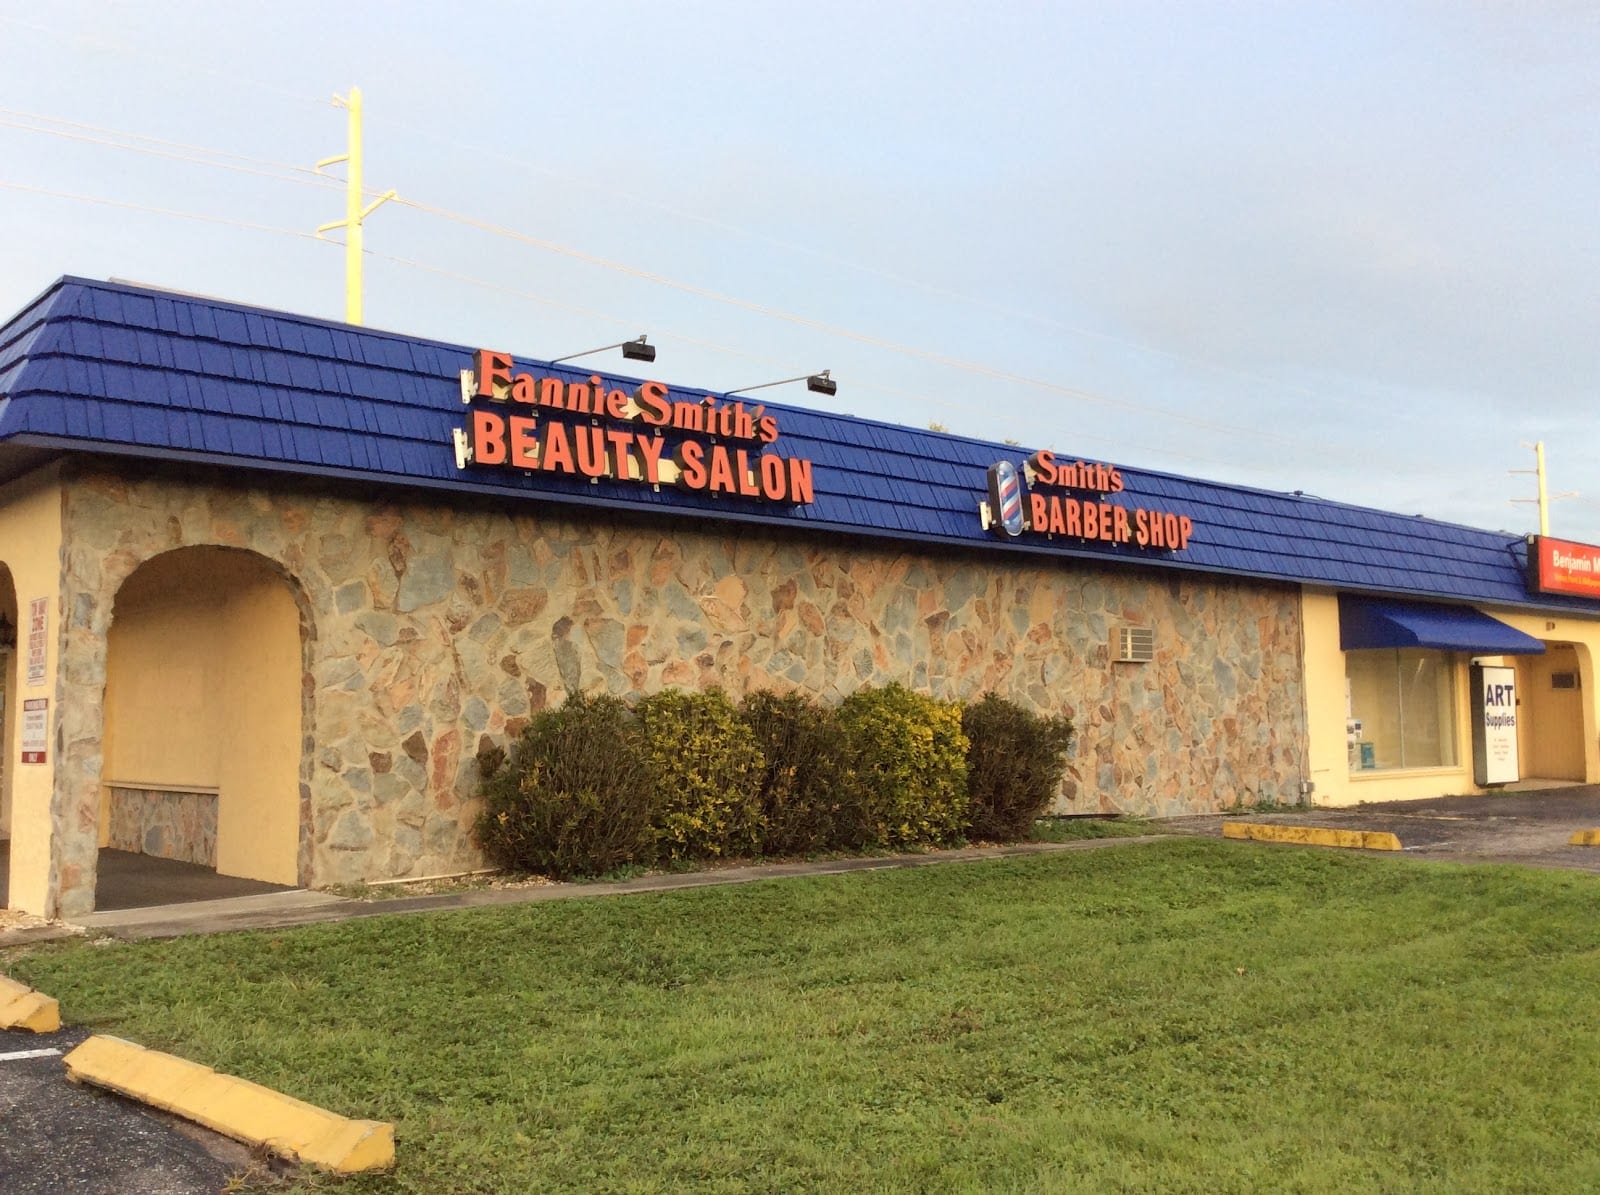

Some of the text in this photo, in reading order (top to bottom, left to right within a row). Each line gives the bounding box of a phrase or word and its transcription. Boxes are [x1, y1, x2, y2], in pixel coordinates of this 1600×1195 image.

[479, 349, 779, 444] Fannie Smith's
[473, 410, 814, 505] BEAUTY SALON
[1036, 450, 1124, 492] Smith's
[1030, 493, 1193, 550] BARBER SHOP
[1553, 550, 1591, 574] Benjamin
[1486, 684, 1514, 706] ART
[1486, 712, 1515, 730] Supplies
